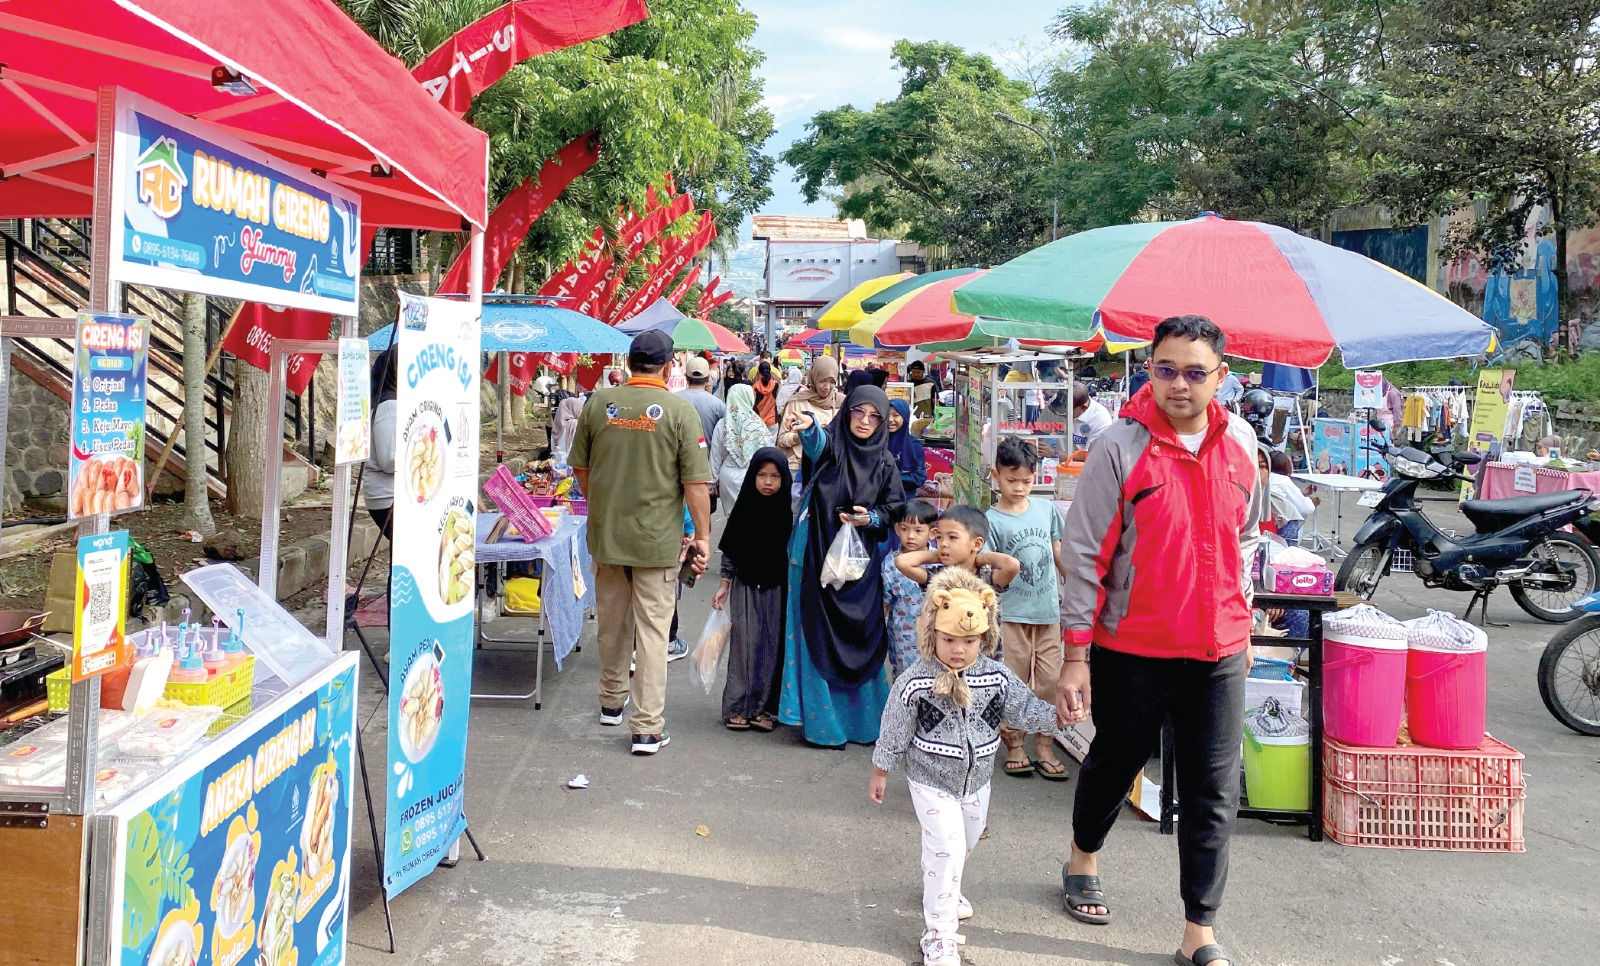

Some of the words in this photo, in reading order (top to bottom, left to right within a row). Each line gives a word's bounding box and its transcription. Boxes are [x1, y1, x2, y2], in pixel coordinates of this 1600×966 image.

[193, 150, 270, 225] RUMAH
[273, 184, 330, 243] CIRENG
[240, 225, 297, 282] Yummy
[82, 324, 125, 348] CIRENG
[127, 329, 143, 349] ISI
[407, 343, 455, 389] CIRENG
[457, 355, 472, 392] ISI
[93, 377, 125, 393] Original
[93, 399, 117, 411] Pedas
[93, 420, 111, 435] Keju
[112, 419, 132, 433] Mayo
[998, 421, 1065, 432] MAKARONI
[1296, 576, 1313, 585] jolly
[400, 648, 417, 684] AYAM
[201, 755, 253, 837] ANEKA
[253, 719, 299, 793] CIRENG
[299, 708, 316, 756] ISI
[400, 795, 433, 826] FROZEN
[415, 812, 435, 832] 0895
[416, 827, 436, 848] 0895
